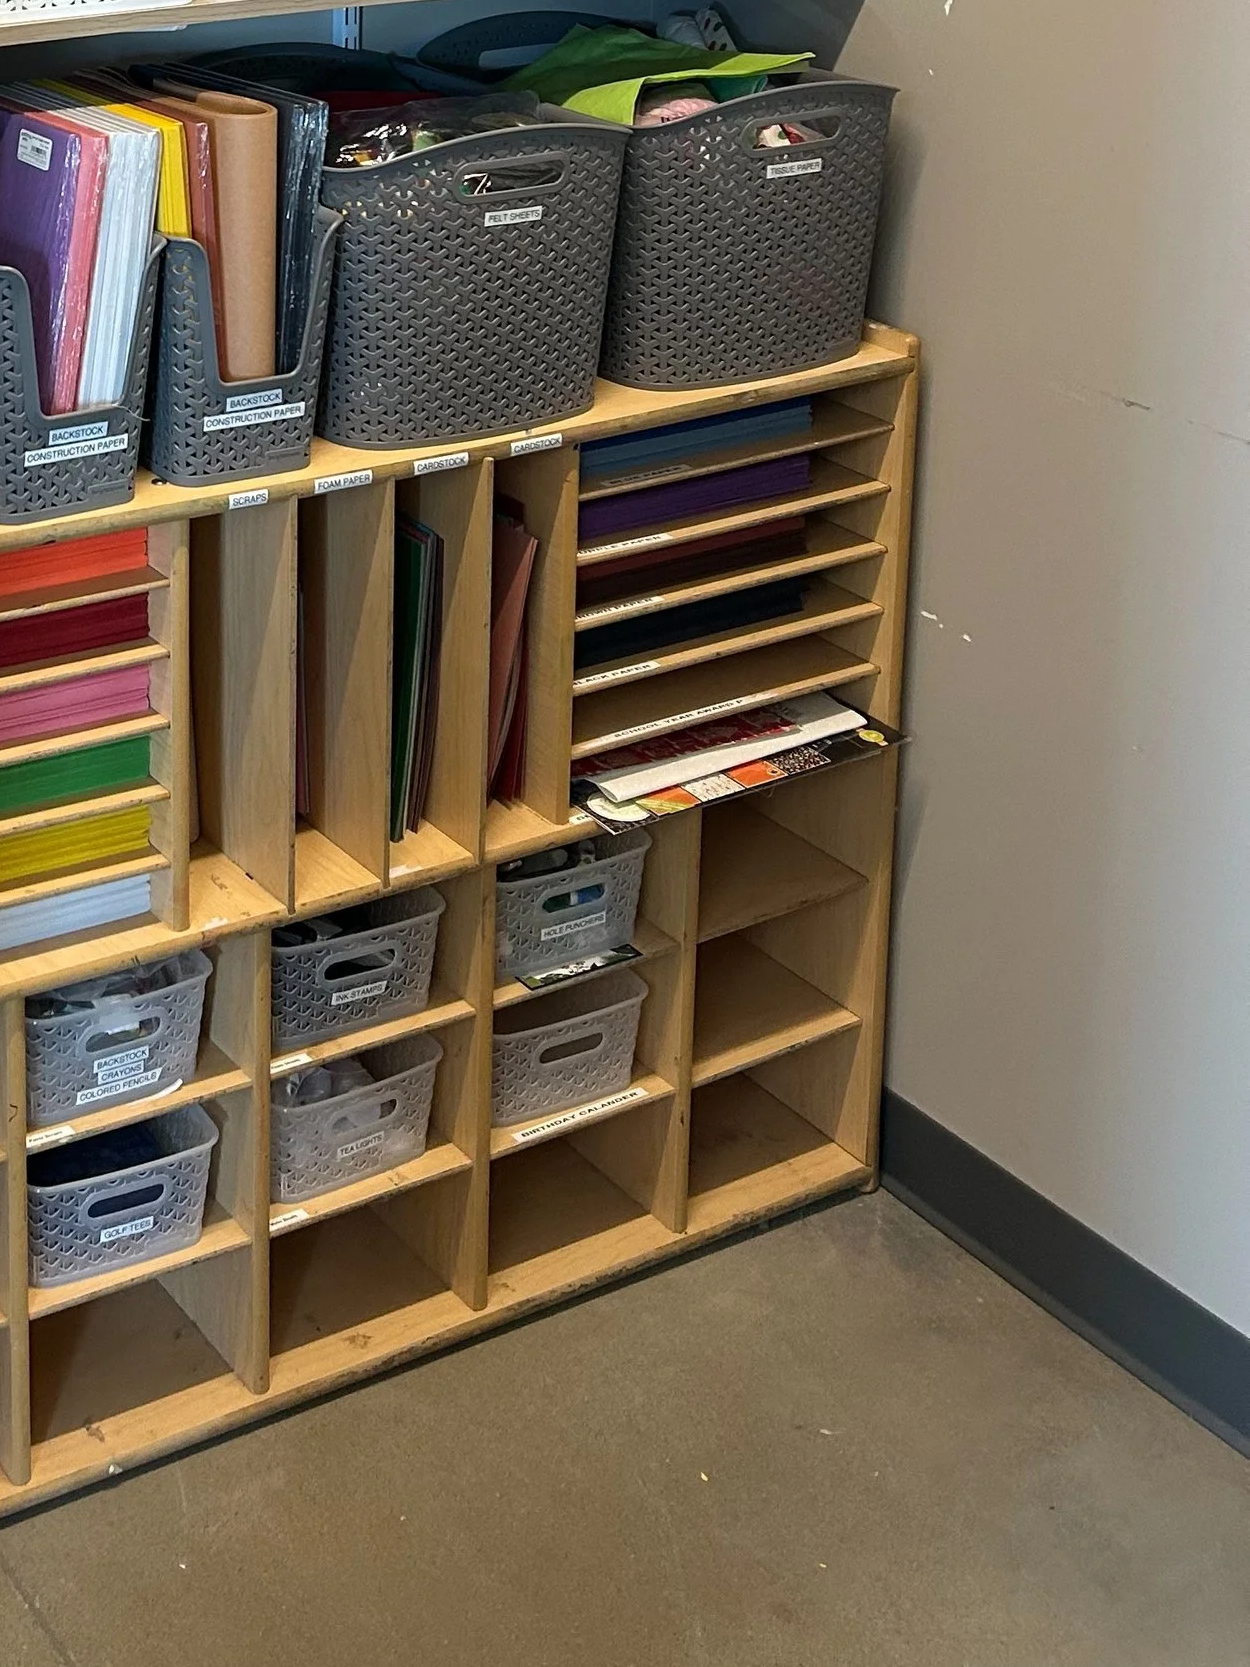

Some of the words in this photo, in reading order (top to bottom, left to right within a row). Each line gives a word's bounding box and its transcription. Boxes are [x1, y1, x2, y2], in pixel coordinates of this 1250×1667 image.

[770, 164, 796, 176] TISSUE
[797, 160, 821, 172] PAPER
[488, 212, 507, 224] FELT
[509, 209, 540, 221] SHEETS
[230, 393, 281, 409] BACKSTOCK
[205, 411, 272, 428] CONSTRUCTION
[273, 406, 302, 418] PAPER
[52, 425, 103, 442] BACKSTOCK
[27, 442, 95, 463] CONSTRUCTION
[97, 437, 126, 452] PAPER
[513, 439, 561, 453] CARDSTOCK
[417, 457, 467, 472] CARDSTOCK
[317, 478, 342, 491] FOAM
[342, 474, 371, 487] PAPER
[232, 493, 267, 507] SCRAPS
[577, 544, 618, 555] URPLE
[621, 535, 662, 547] PAPER
[575, 607, 612, 620] ROWN
[611, 663, 652, 677] PAPER
[613, 722, 661, 738] SCHOOL
[664, 711, 694, 725] YEAR
[696, 701, 734, 716] AWARD
[544, 926, 565, 938] HOLE
[566, 915, 604, 931] PUNCHERS
[336, 993, 349, 1003] INK
[351, 985, 384, 998] STAMPS
[96, 1051, 147, 1070] BACKSTOCK
[101, 1065, 142, 1081] CRAYONS
[79, 1083, 119, 1102] COLORED
[120, 1073, 157, 1089] PENCILS
[521, 1115, 577, 1137] BIRTHDAY
[579, 1091, 637, 1116] CALANDER
[340, 1145, 357, 1156] TEA
[358, 1135, 382, 1150] LIGHTS
[104, 1226, 126, 1239] GOLF
[127, 1220, 151, 1232] TEES
